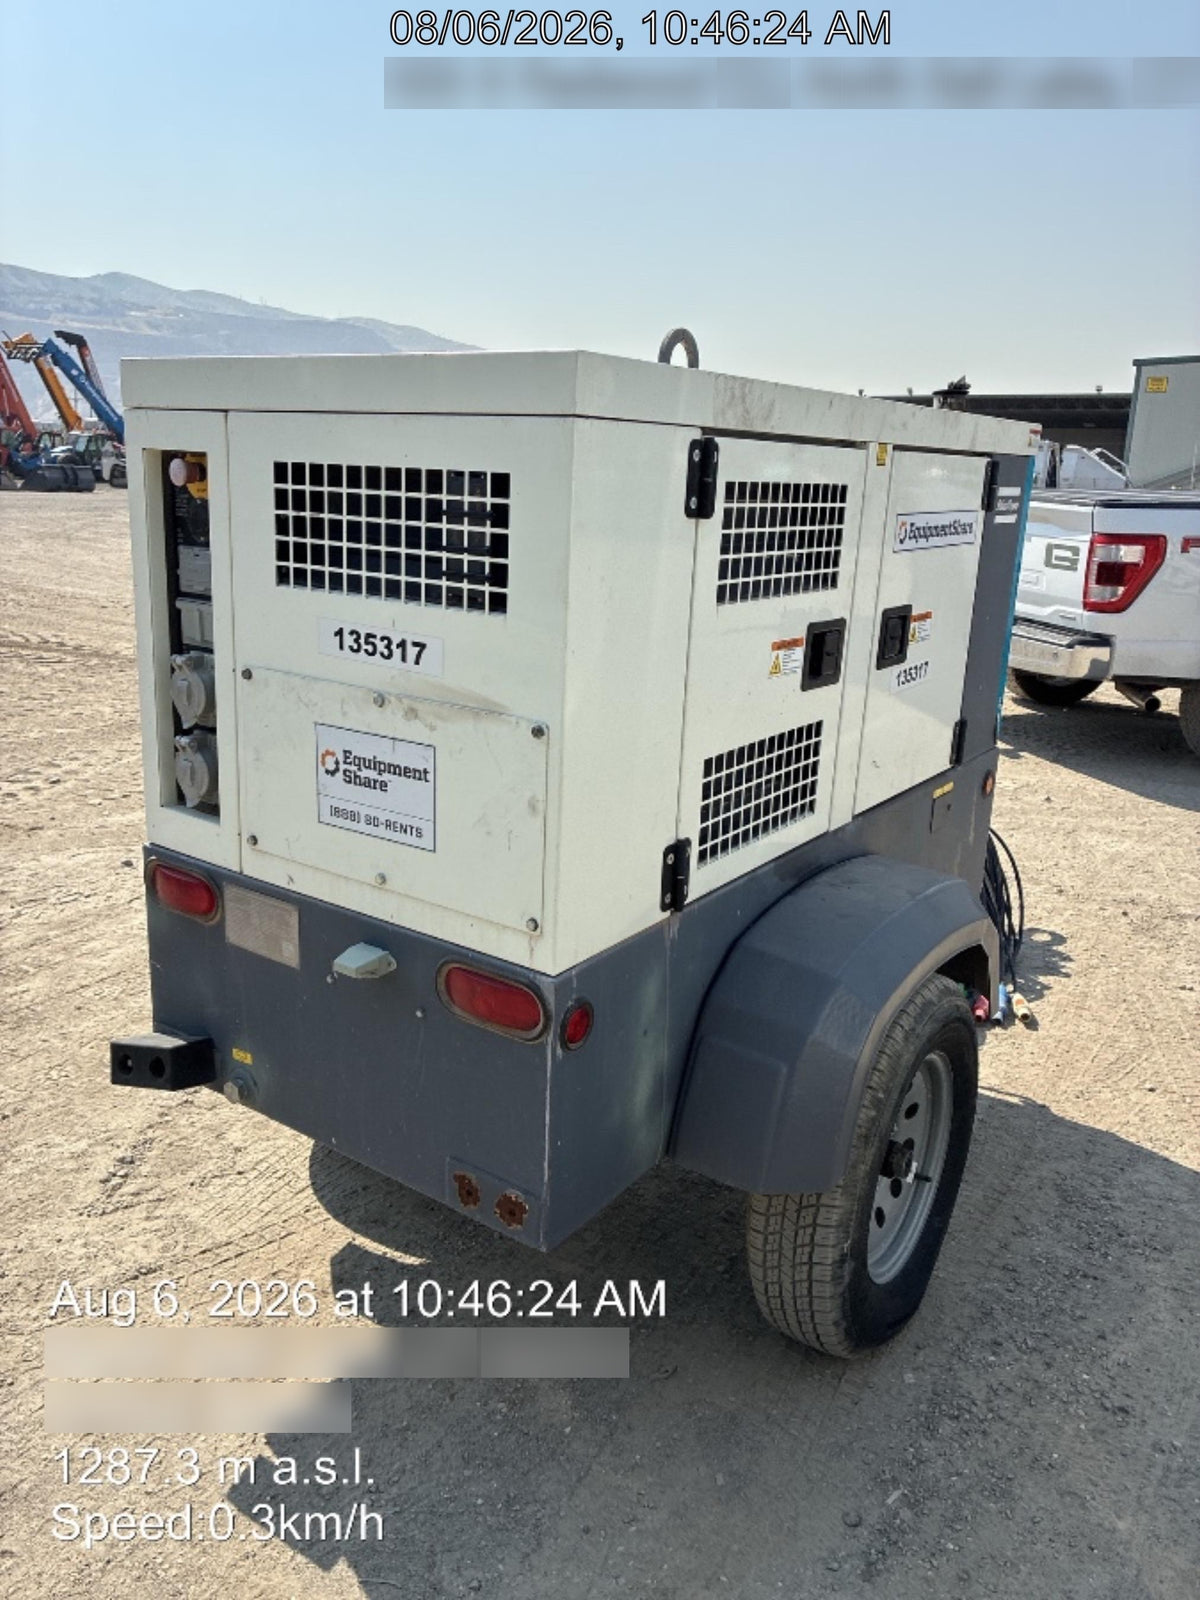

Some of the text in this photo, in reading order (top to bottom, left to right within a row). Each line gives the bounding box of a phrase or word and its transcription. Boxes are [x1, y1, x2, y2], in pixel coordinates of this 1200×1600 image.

[333, 626, 427, 666] 135317
[895, 660, 929, 686] 135317
[342, 749, 431, 782] Equipment
[342, 767, 389, 792] Share
